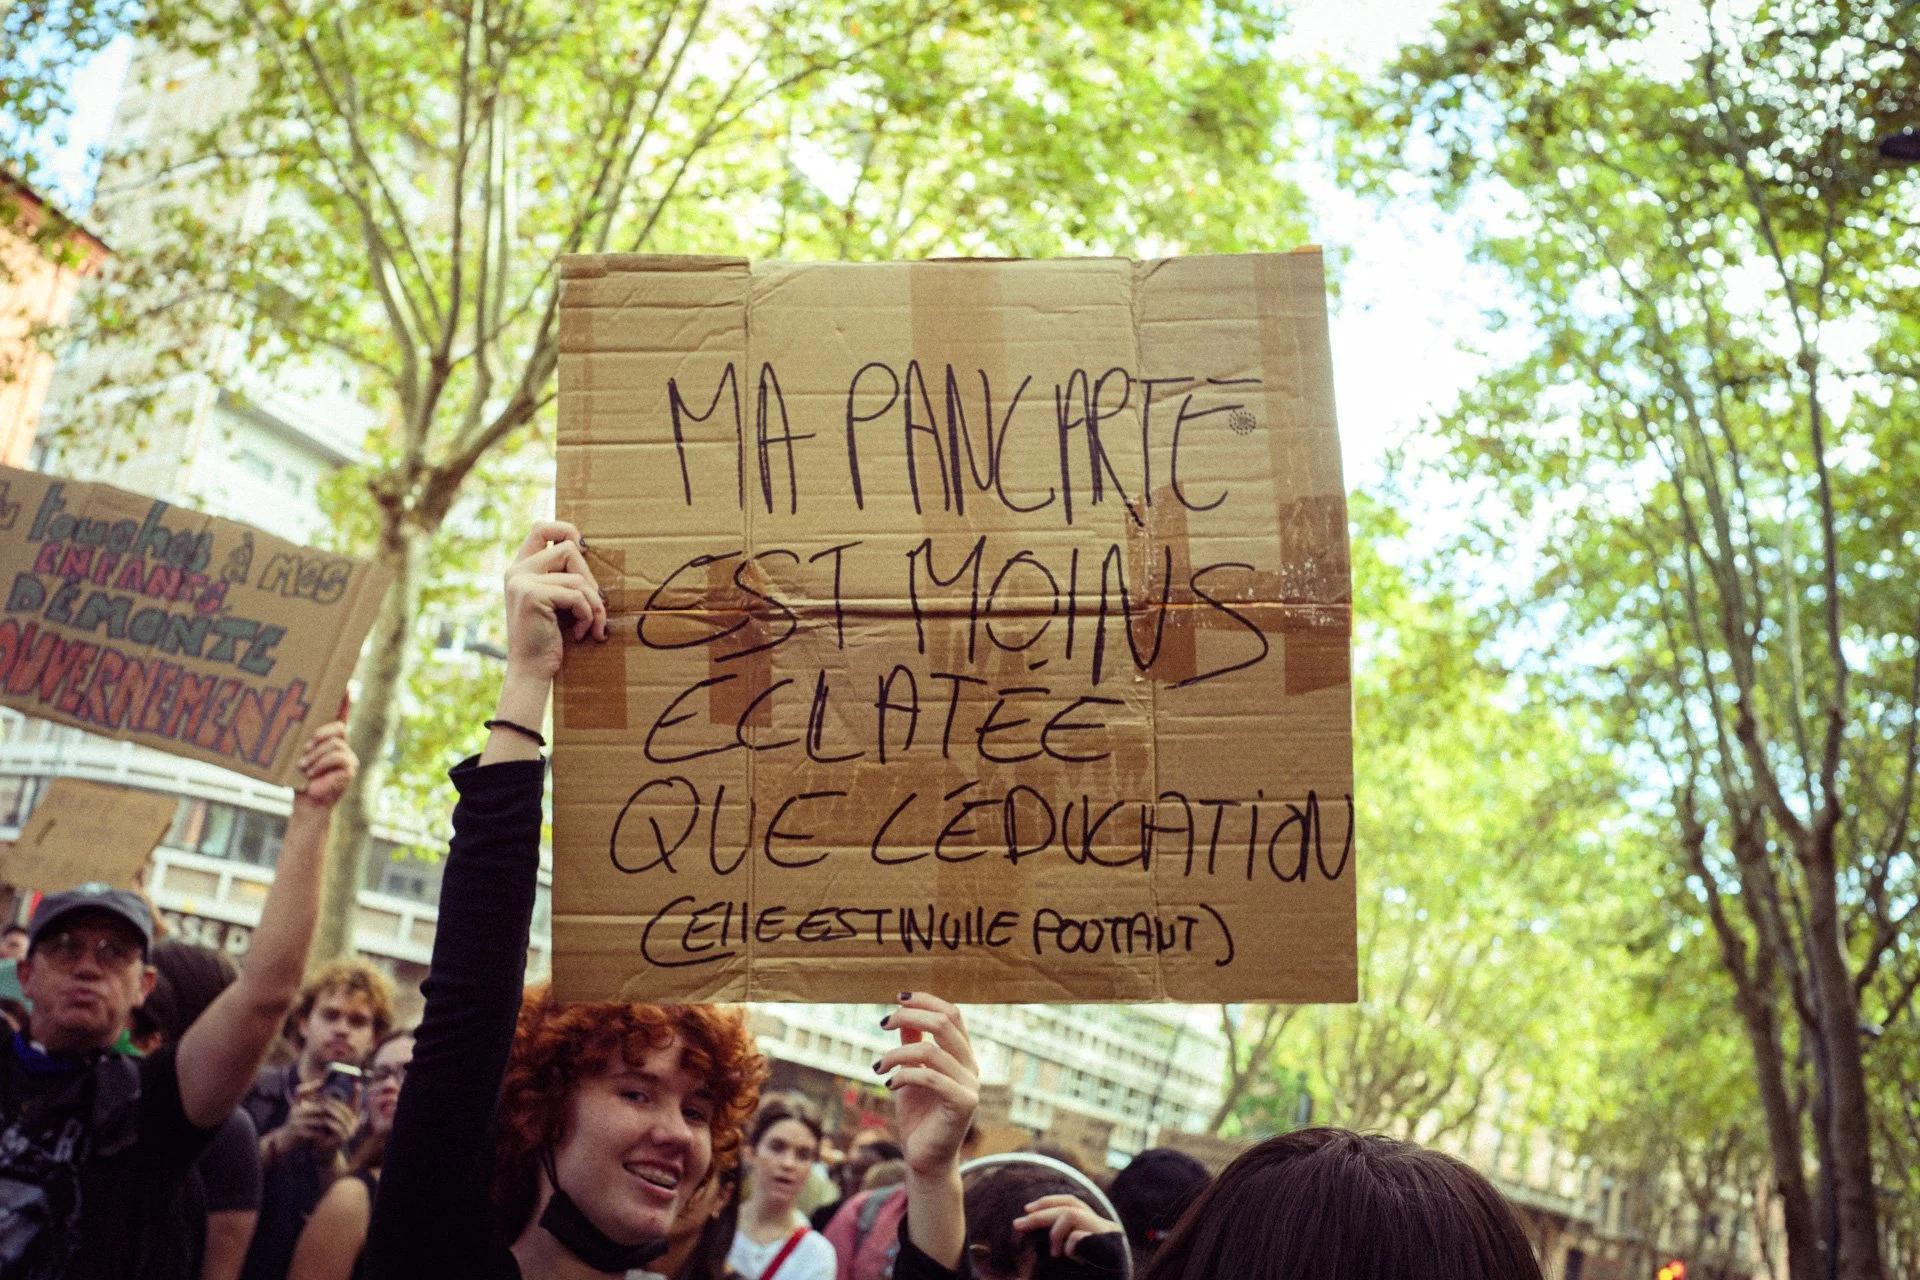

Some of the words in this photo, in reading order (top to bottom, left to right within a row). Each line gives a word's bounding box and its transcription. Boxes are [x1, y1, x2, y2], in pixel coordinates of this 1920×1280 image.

[667, 362, 816, 514] MA
[846, 359, 1262, 528] PANCARTE
[638, 541, 864, 662] EST
[906, 535, 1269, 690] MOINS
[610, 776, 848, 876] QUE
[796, 905, 893, 946] EST
